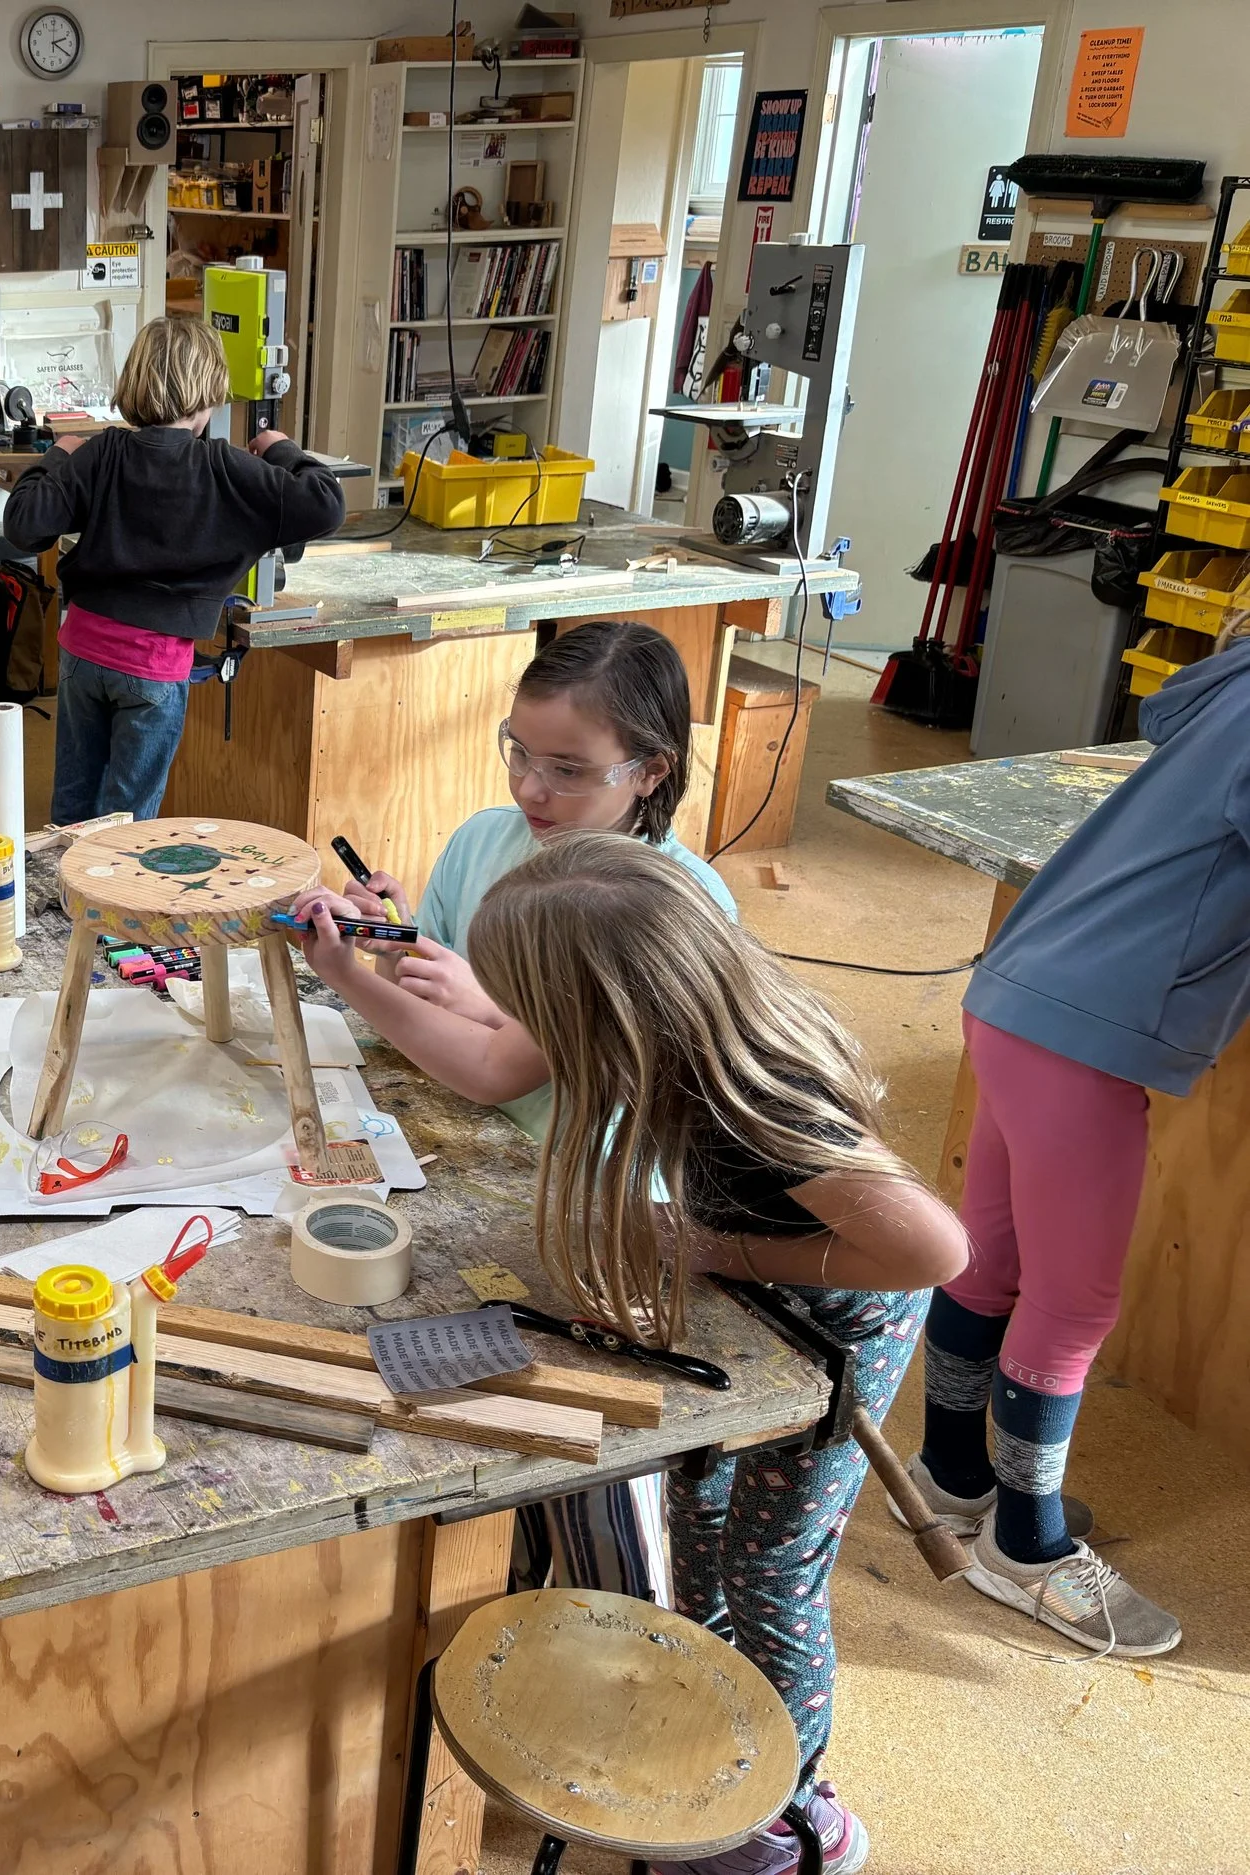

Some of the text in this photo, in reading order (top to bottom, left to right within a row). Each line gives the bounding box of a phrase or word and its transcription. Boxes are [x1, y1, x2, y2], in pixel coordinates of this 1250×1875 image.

[1090, 38, 1115, 46] CLEANUP
[761, 99, 791, 115] SHOW
[754, 139, 796, 159] BE KIND
[758, 215, 770, 224] FIRE
[95, 244, 136, 256] CAUTION
[1044, 235, 1071, 245] BROOMS
[112, 267, 137, 275] protection
[1097, 243, 1114, 299] AND BROOMS
[37, 364, 83, 373] SAFETY GLASSES
[225, 845, 284, 865] Magic
[444, 1326, 460, 1352] MADE
[455, 1353, 466, 1362] IN
[462, 1324, 478, 1350] MADE
[473, 1351, 484, 1361] IN
[479, 1322, 495, 1347] MADE
[496, 1320, 513, 1345] MADE
[374, 1335, 391, 1362] MADE
[385, 1363, 395, 1372] IN
[392, 1332, 408, 1359] MADE
[402, 1360, 413, 1370] IN
[409, 1330, 426, 1357] MADE
[420, 1358, 430, 1368] IN
[427, 1328, 443, 1354] MADE
[438, 1356, 448, 1365] IN
[1007, 1362, 1056, 1387] FLEO
